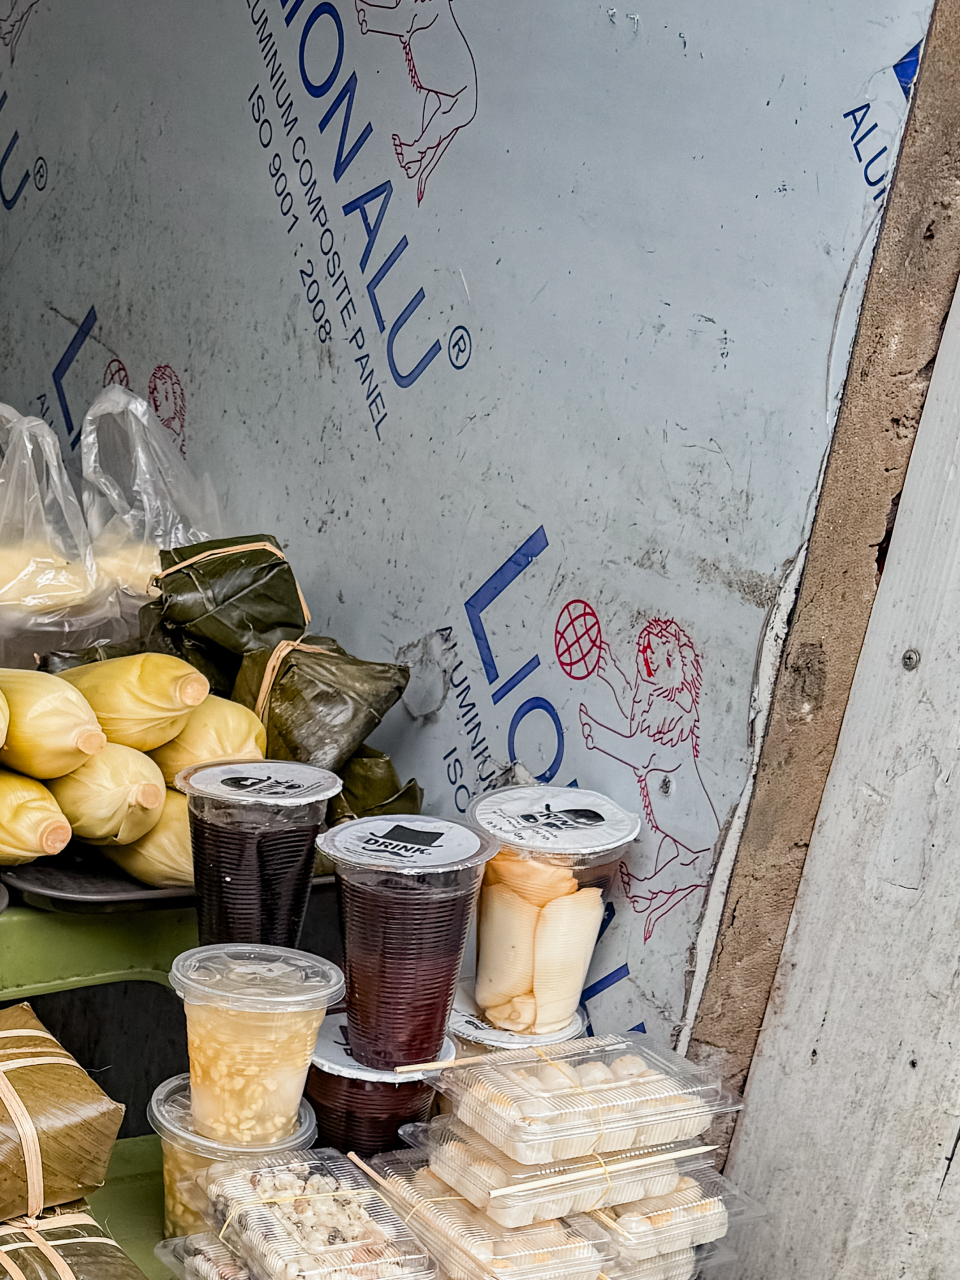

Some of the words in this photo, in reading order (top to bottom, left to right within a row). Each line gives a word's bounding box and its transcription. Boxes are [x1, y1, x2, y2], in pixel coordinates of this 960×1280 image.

[246, 0, 299, 136] UMINIUM
[293, 136, 357, 328] COMPOSITE
[349, 326, 388, 442] PANEL
[248, 84, 273, 148] ISO
[269, 153, 299, 234] 9001
[299, 259, 333, 344] 2008
[464, 525, 579, 788] LIO
[363, 837, 428, 855] DRINK
